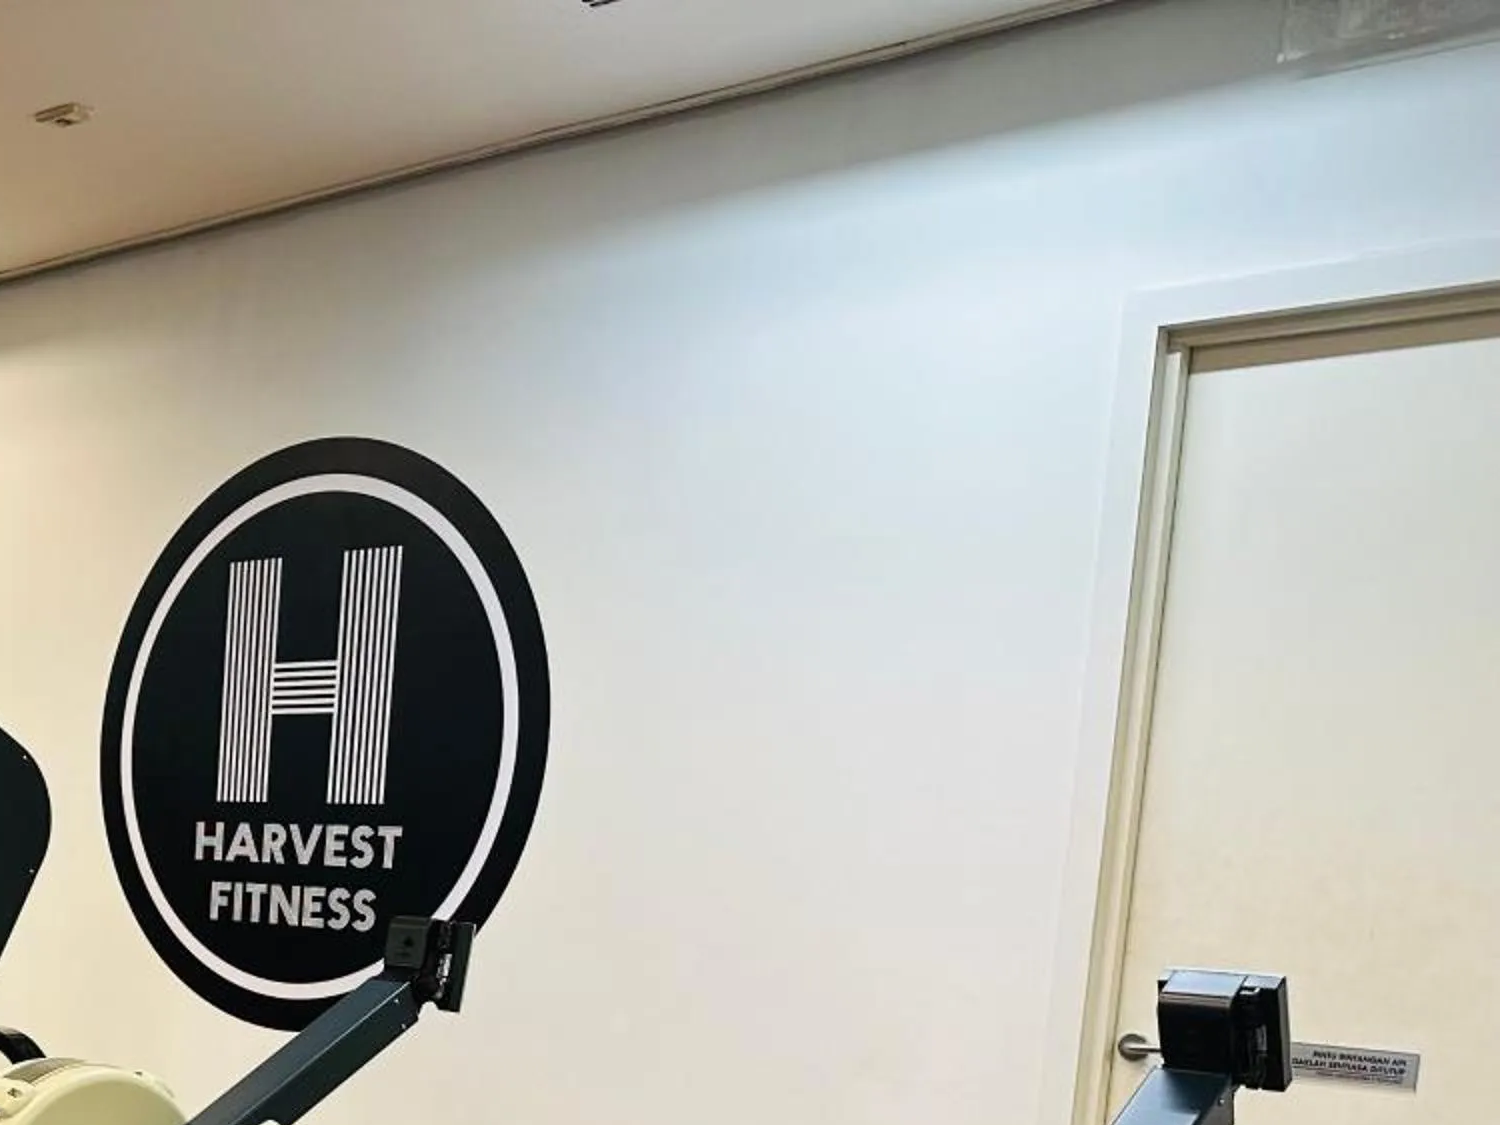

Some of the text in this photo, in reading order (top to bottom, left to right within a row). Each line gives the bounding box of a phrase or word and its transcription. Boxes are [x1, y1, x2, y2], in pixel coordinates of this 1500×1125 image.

[216, 545, 403, 804] H
[194, 821, 403, 869] HARVEST
[209, 881, 377, 932] FITNESS
